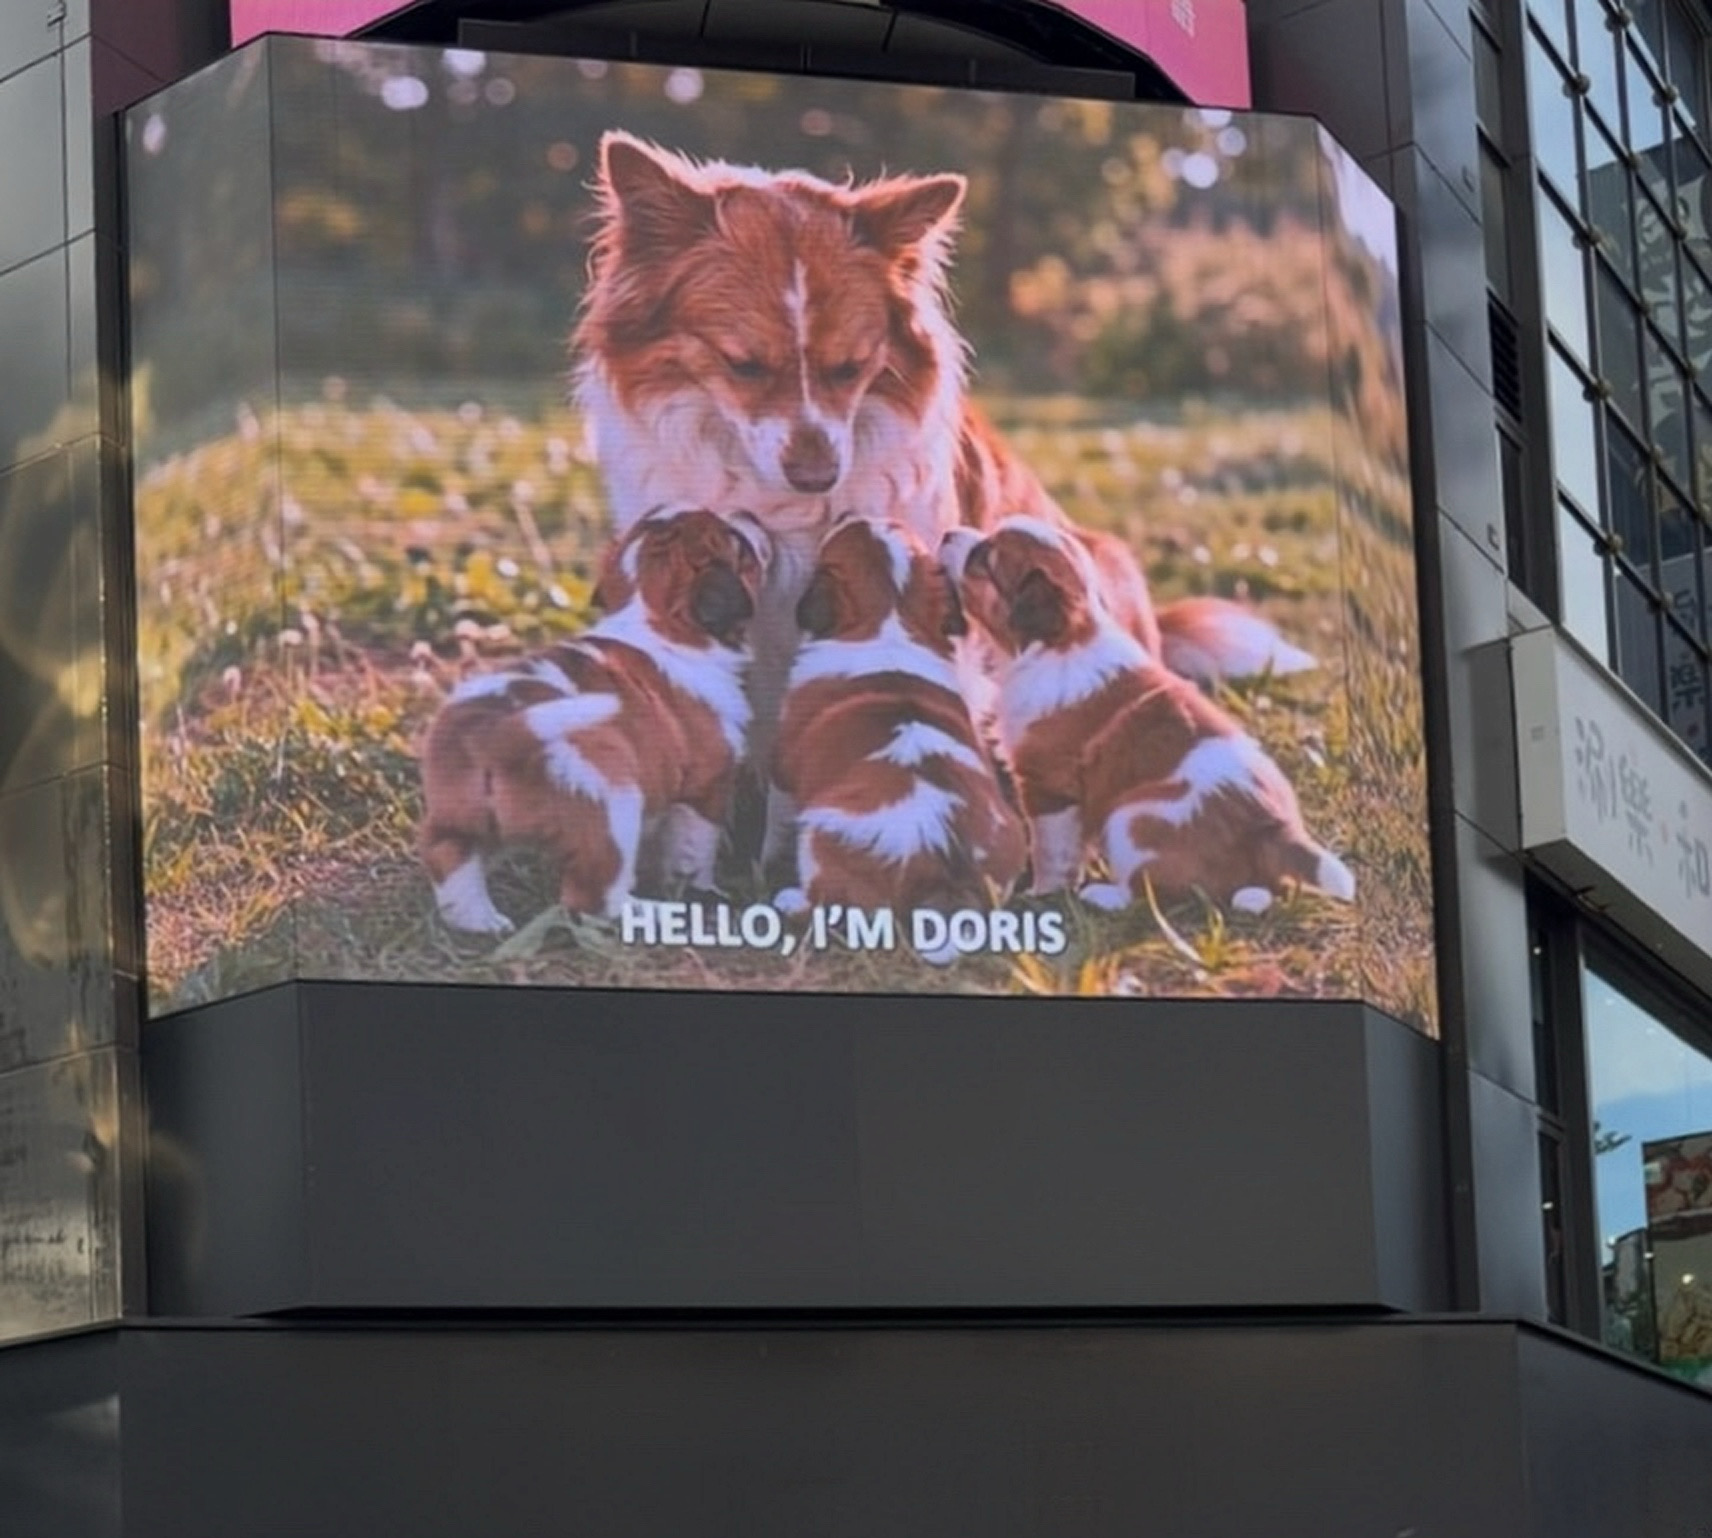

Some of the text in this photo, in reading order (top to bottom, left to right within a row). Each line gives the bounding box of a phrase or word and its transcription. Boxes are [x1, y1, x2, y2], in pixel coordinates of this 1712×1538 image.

[620, 902, 1066, 956] HELLO, I’M DORIS
